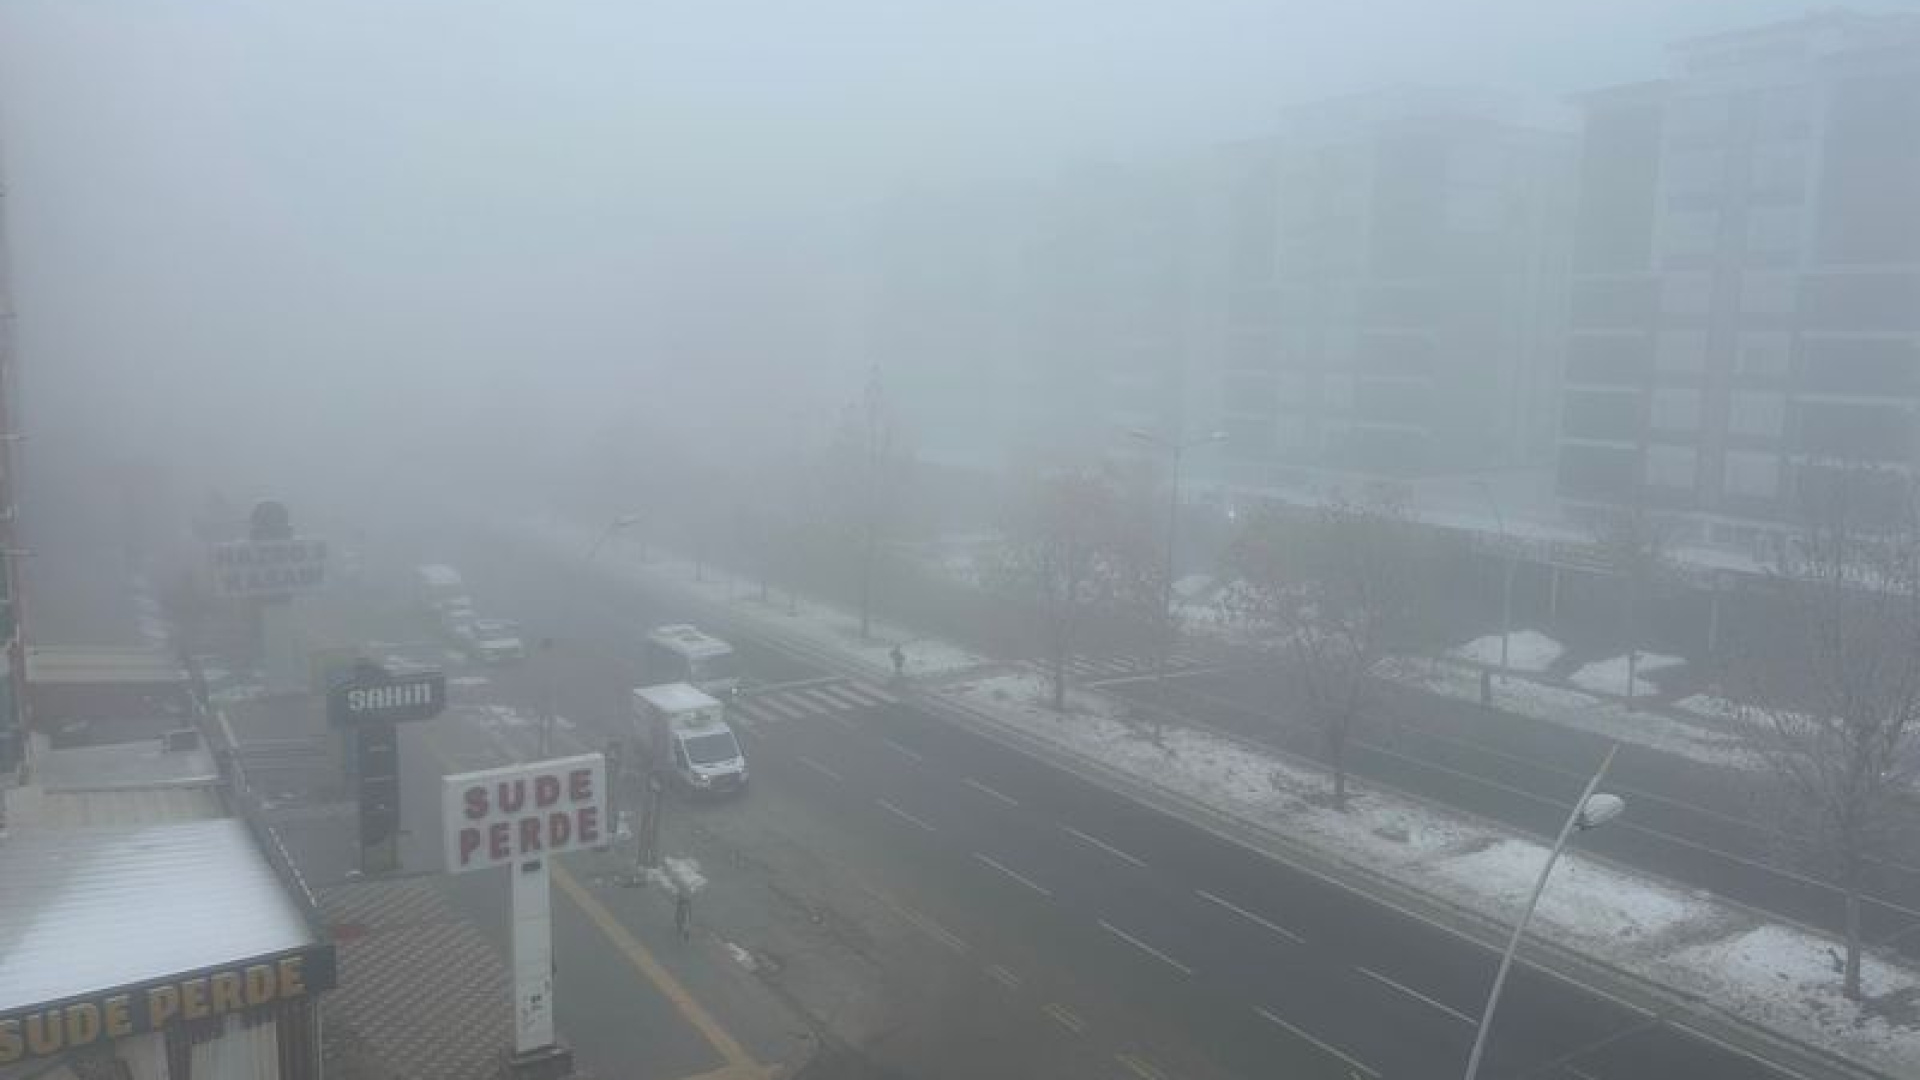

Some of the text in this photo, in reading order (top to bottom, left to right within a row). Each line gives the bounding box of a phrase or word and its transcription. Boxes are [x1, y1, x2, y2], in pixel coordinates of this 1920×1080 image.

[463, 768, 593, 821] SUDE
[459, 805, 598, 867] PERDE
[0, 956, 306, 1062] SUDE PERDE
